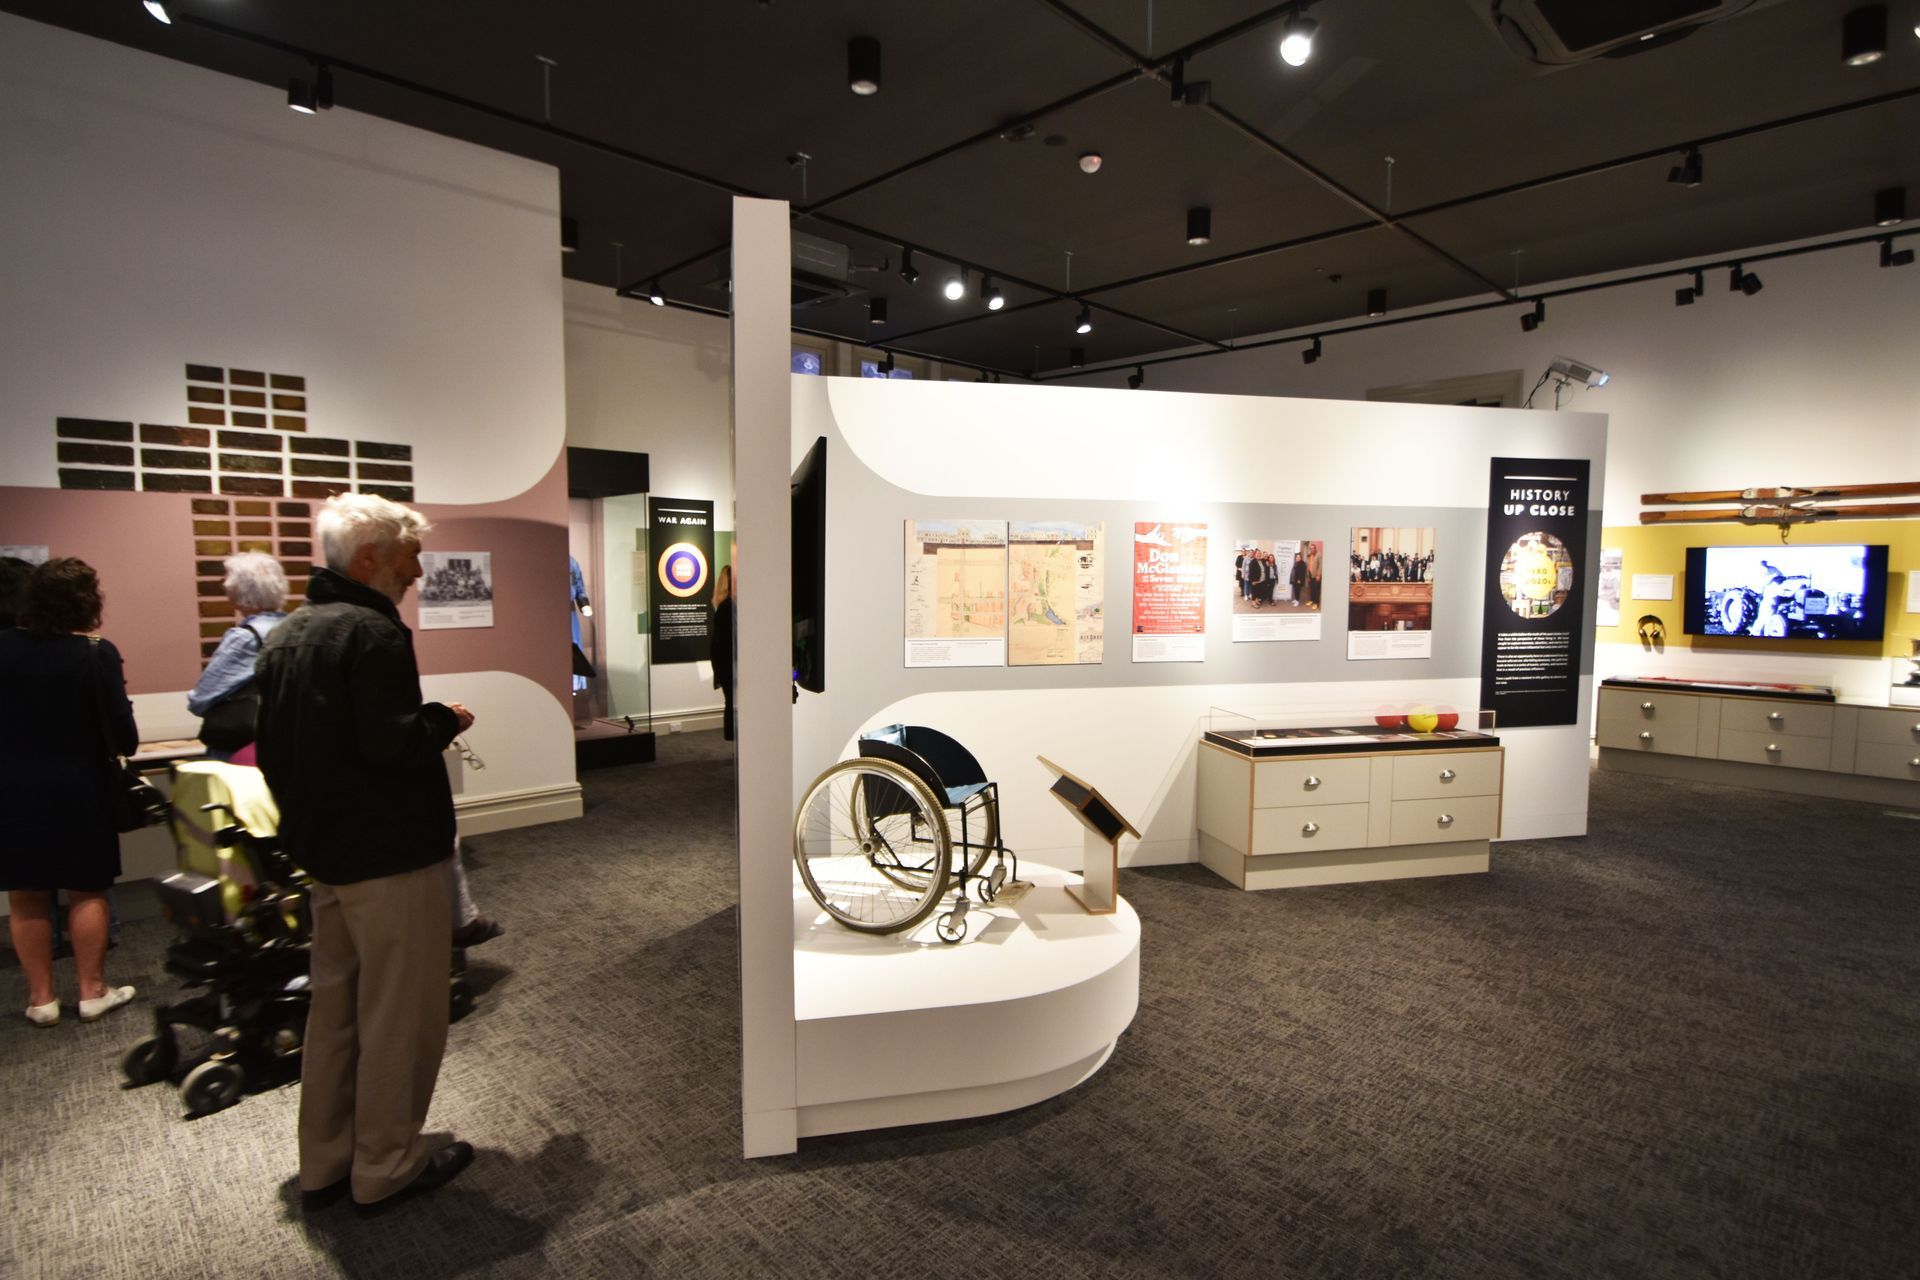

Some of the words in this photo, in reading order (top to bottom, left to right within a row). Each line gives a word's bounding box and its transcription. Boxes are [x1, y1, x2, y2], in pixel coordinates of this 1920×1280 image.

[1510, 489, 1570, 501] HISTORY
[1504, 504, 1525, 516] UP
[1529, 504, 1575, 516] CLOSE
[658, 516, 677, 525] WAR
[680, 516, 707, 525] AGAIN
[1149, 548, 1179, 563] Don
